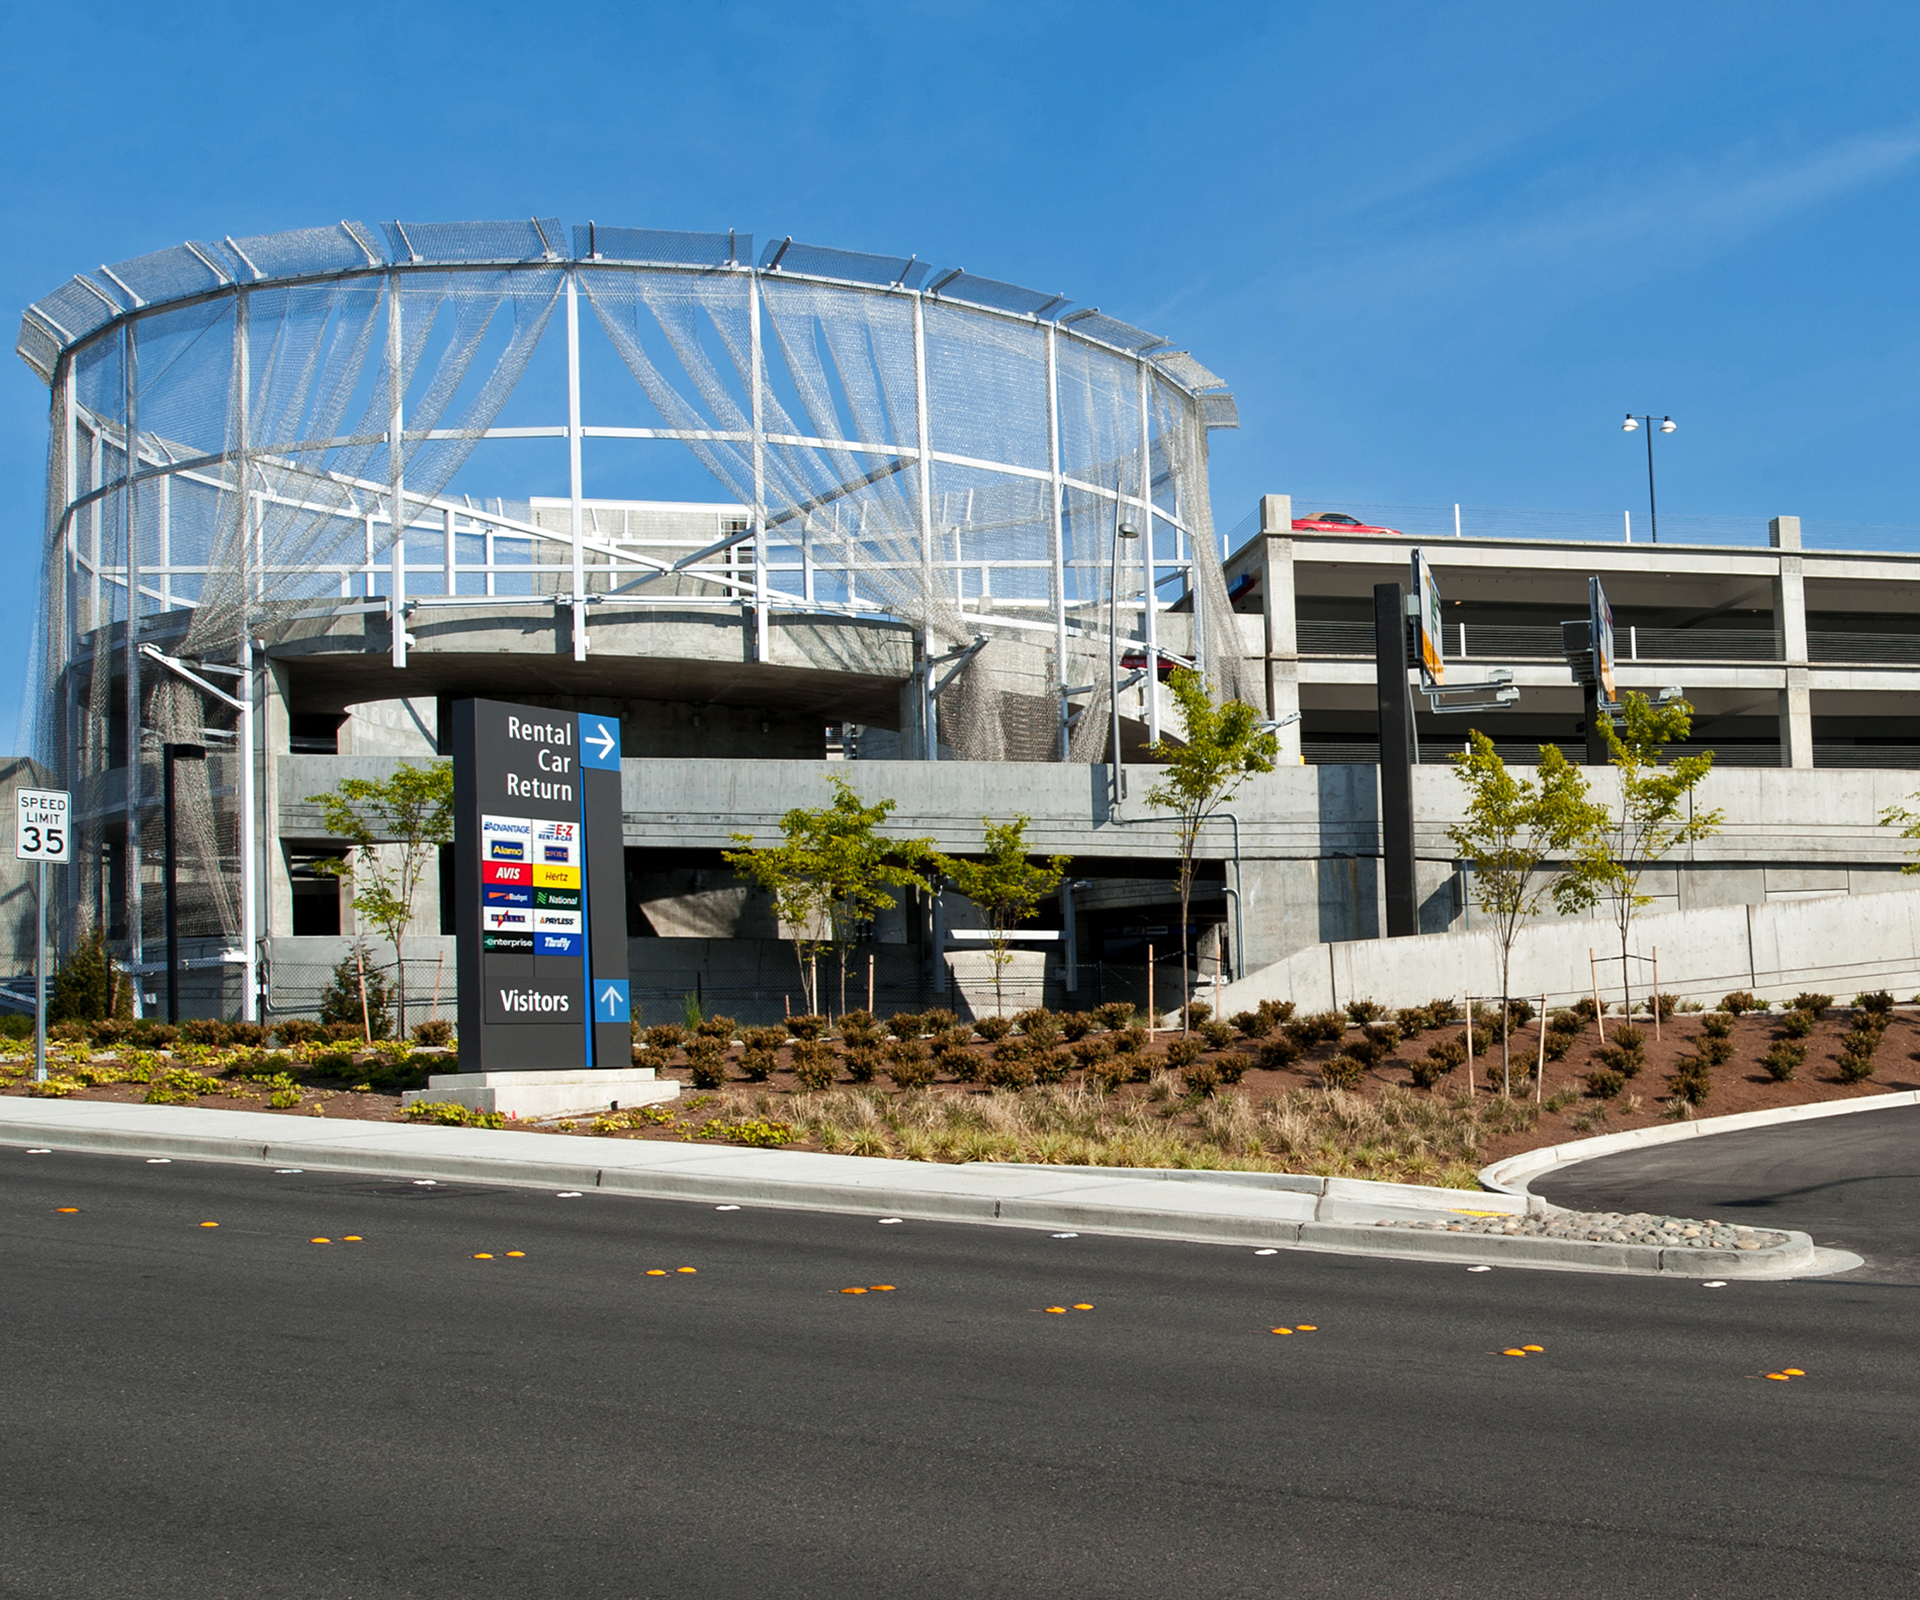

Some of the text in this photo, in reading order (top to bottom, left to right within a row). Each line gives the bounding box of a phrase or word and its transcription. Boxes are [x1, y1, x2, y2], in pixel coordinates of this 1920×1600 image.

[508, 715, 571, 746] Rental
[538, 748, 571, 773] Car
[507, 773, 572, 801] Return
[21, 796, 66, 811] SPEED
[26, 812, 60, 825] LIMIT
[489, 822, 531, 834] ADVANTAGE
[556, 824, 573, 835] E-Z
[22, 826, 64, 854] 35
[538, 833, 572, 842] RENT-A-CAR
[493, 845, 523, 856] Alamo
[496, 867, 520, 880] AVIS
[545, 871, 569, 882] Hertz
[509, 893, 528, 903] Budget
[548, 895, 578, 905] National
[492, 914, 525, 922] DOLLAR
[544, 917, 575, 925] PAYLESS
[486, 938, 533, 948] enterprise
[544, 937, 571, 951] Thrifty
[500, 989, 569, 1012] Visitors
